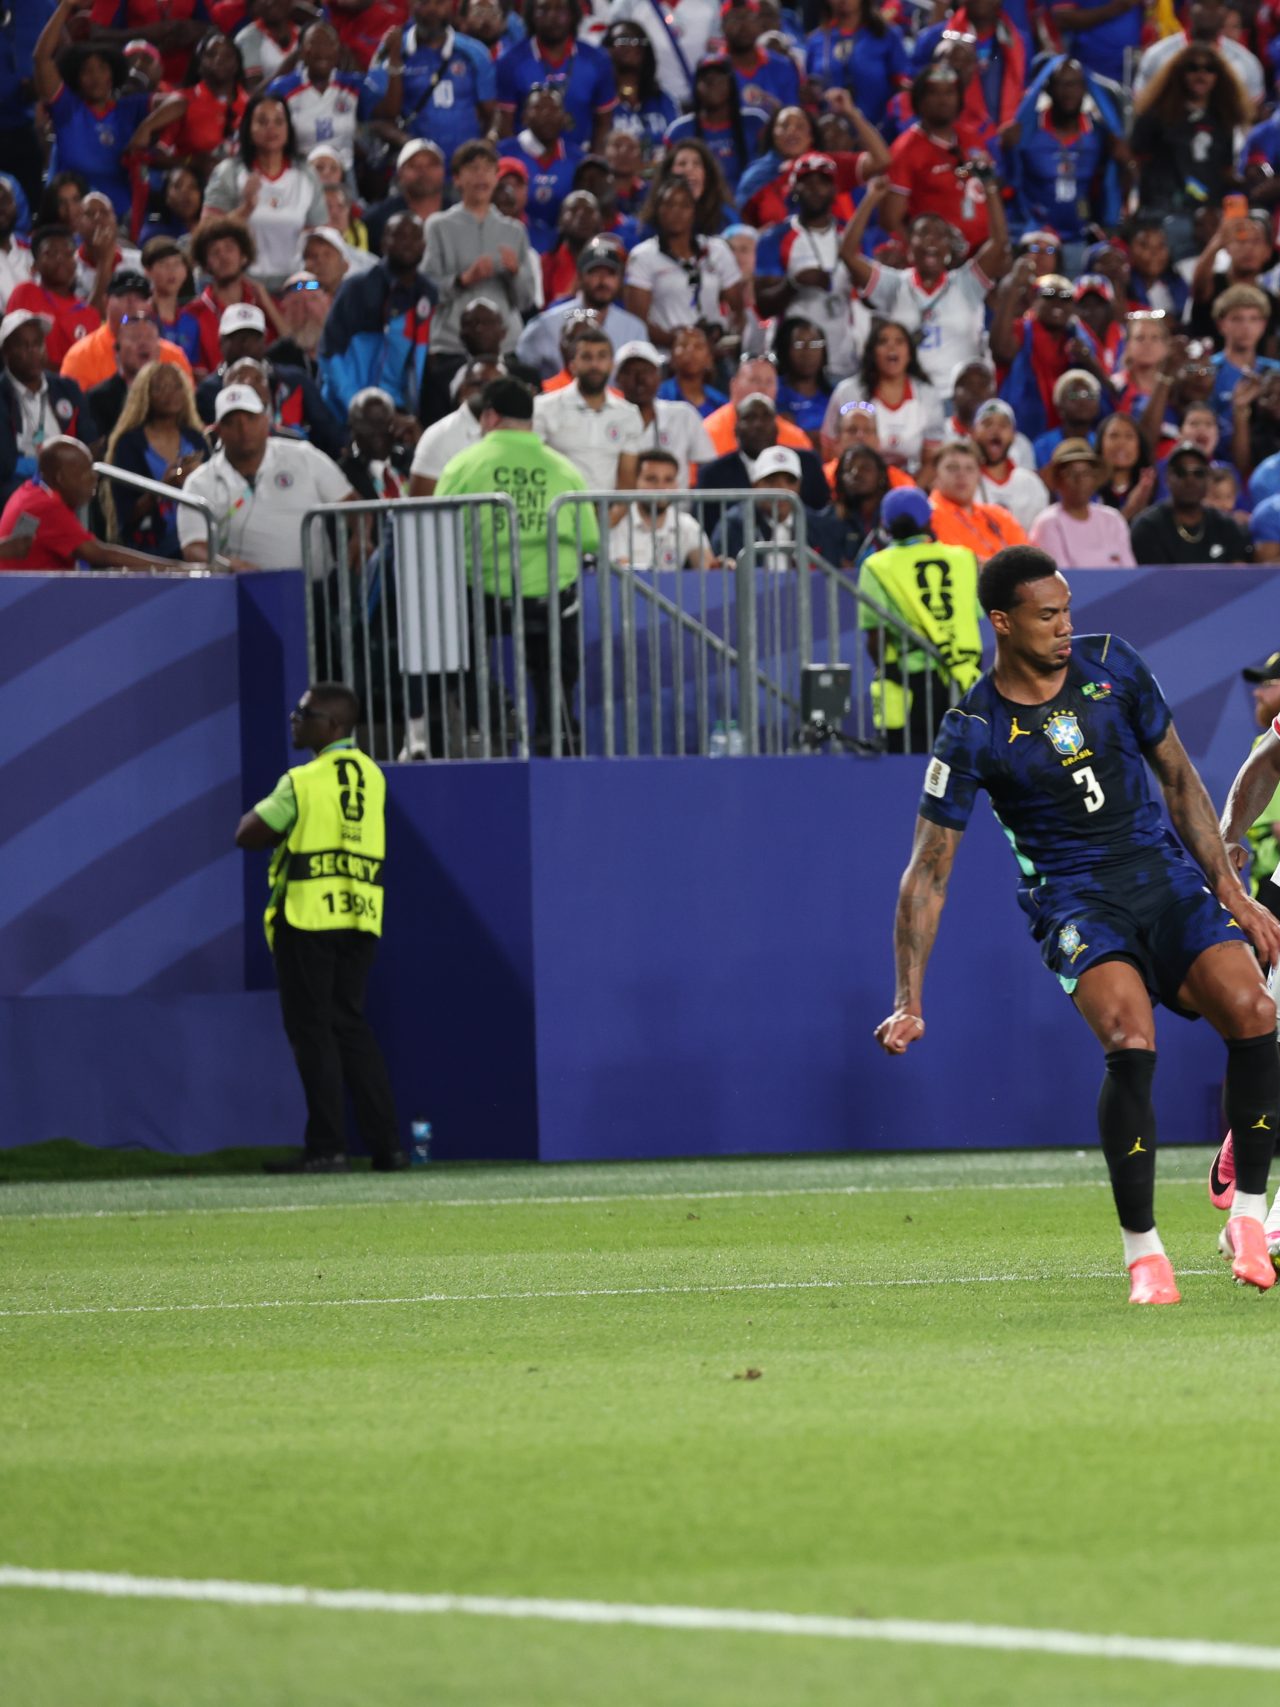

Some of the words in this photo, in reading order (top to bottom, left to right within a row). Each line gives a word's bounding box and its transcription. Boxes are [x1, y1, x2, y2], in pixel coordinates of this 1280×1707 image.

[493, 466, 547, 486] CSC
[494, 509, 548, 533] SAFF
[1071, 765, 1106, 813] 3
